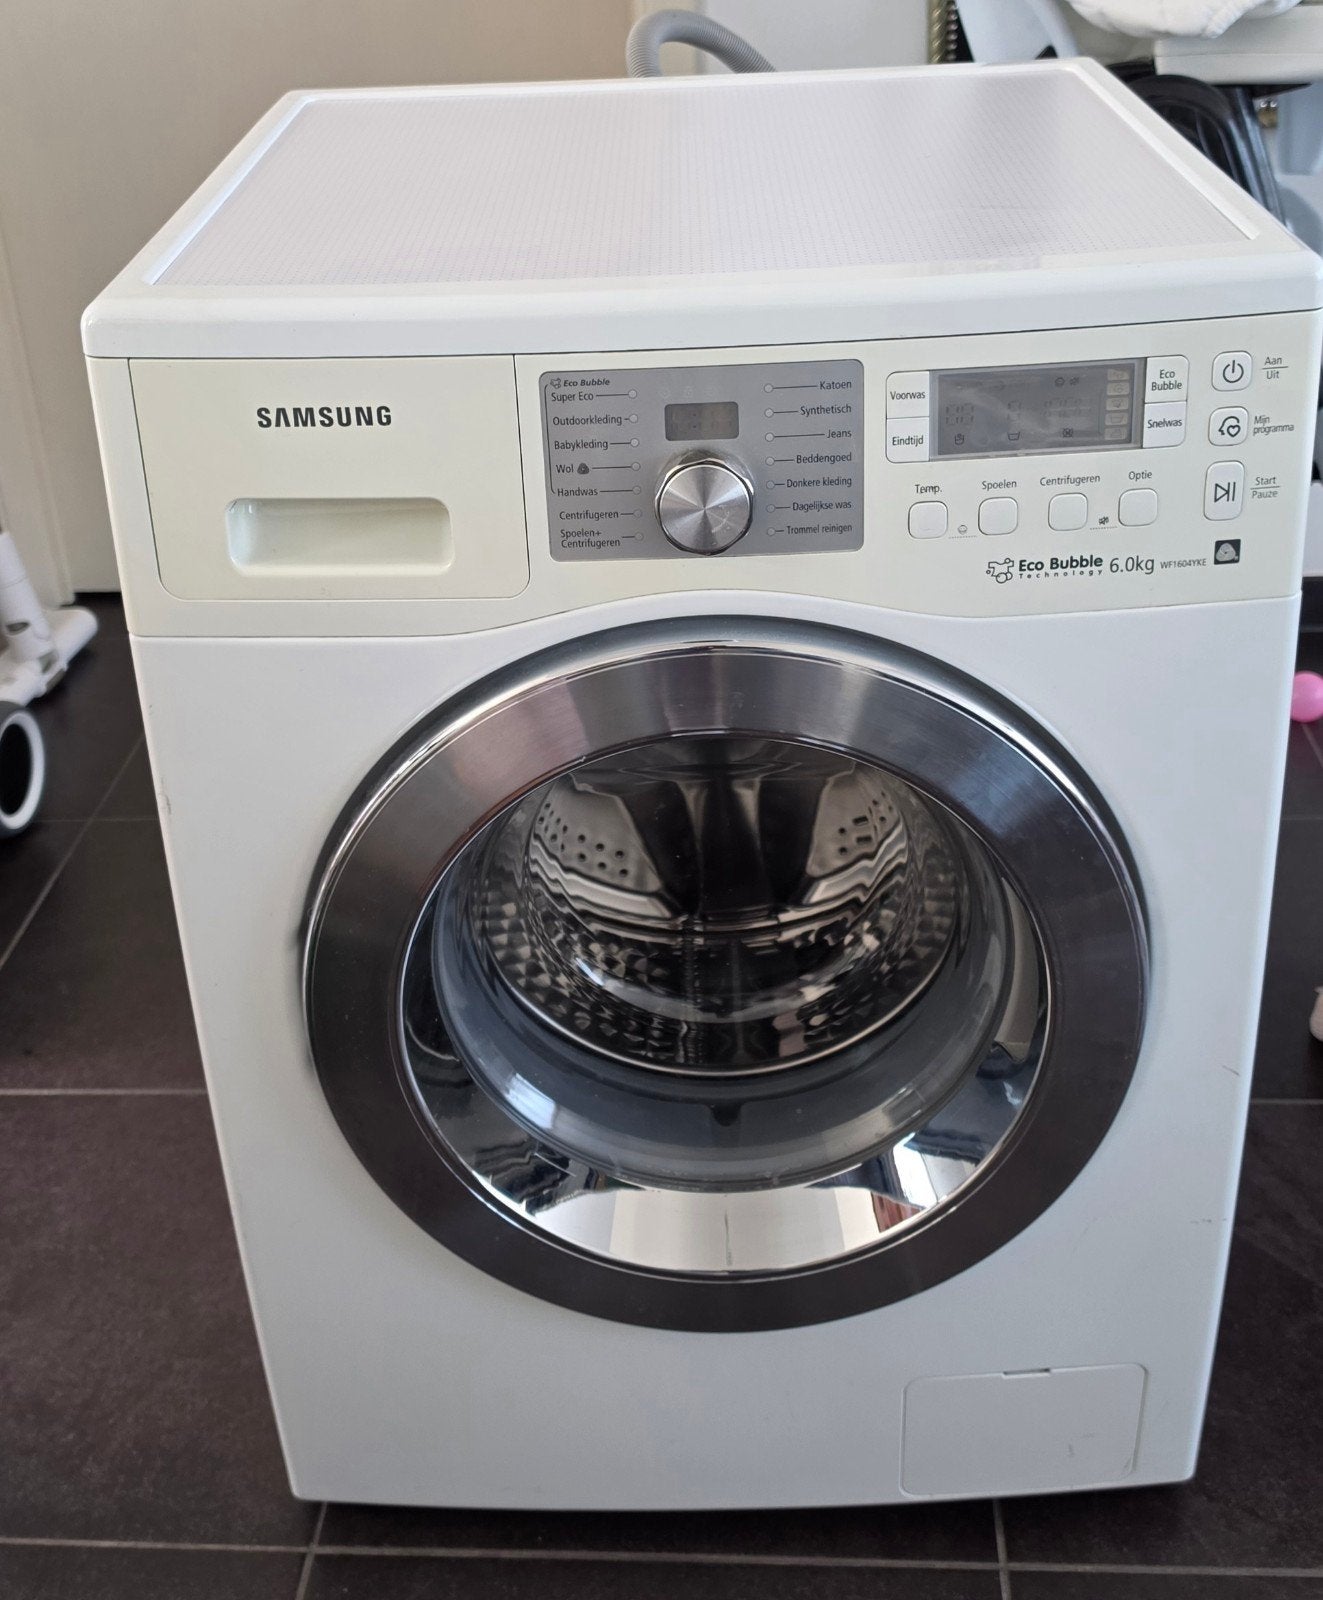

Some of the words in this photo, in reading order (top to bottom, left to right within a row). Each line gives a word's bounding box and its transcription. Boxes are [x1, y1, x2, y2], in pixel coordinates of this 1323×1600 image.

[1264, 356, 1283, 366] Aan
[1159, 368, 1176, 380] Eco
[1266, 370, 1280, 380] Uit
[580, 378, 610, 386] Bubble
[819, 380, 852, 390] Katoen
[1151, 379, 1183, 391] Bubble
[551, 392, 575, 403] Super
[578, 391, 594, 401] Eco
[890, 390, 926, 401] Voorwas
[256, 405, 392, 429] SAMSUNG
[800, 405, 852, 417] Synthetisch
[552, 414, 622, 426] Outdoorkleding
[1147, 417, 1183, 429] Snelwas
[1254, 415, 1271, 426] Mijn
[827, 429, 852, 438] Jeans
[1252, 424, 1295, 436] programma
[554, 439, 608, 451] Babykleding
[891, 434, 924, 447] Eindtijd
[796, 452, 852, 465] Beddengoed
[556, 464, 574, 473] Wol
[1039, 473, 1101, 487] Centrifugeren
[1128, 470, 1153, 482] Optie
[1255, 476, 1276, 486] Start
[786, 479, 821, 489] Donkere
[822, 477, 852, 488] kleding
[981, 479, 1018, 491] Spoelen
[557, 487, 598, 497] Handwas
[914, 484, 943, 495] Temp.
[1251, 490, 1278, 499] Pauze
[792, 502, 834, 513] Dagelijkse
[835, 501, 852, 509] was
[559, 510, 619, 521] Centrifugeren
[560, 529, 602, 539] Spoelen+
[787, 525, 820, 535] Trommel
[822, 523, 853, 534] reinigen
[561, 538, 621, 549] Centrifugeren
[1018, 559, 1045, 572] Eco
[1049, 555, 1104, 570] Bubble
[1109, 556, 1155, 575] 6.0kg
[1160, 558, 1207, 569] WF1604YKE
[1018, 569, 1104, 580] Technology
